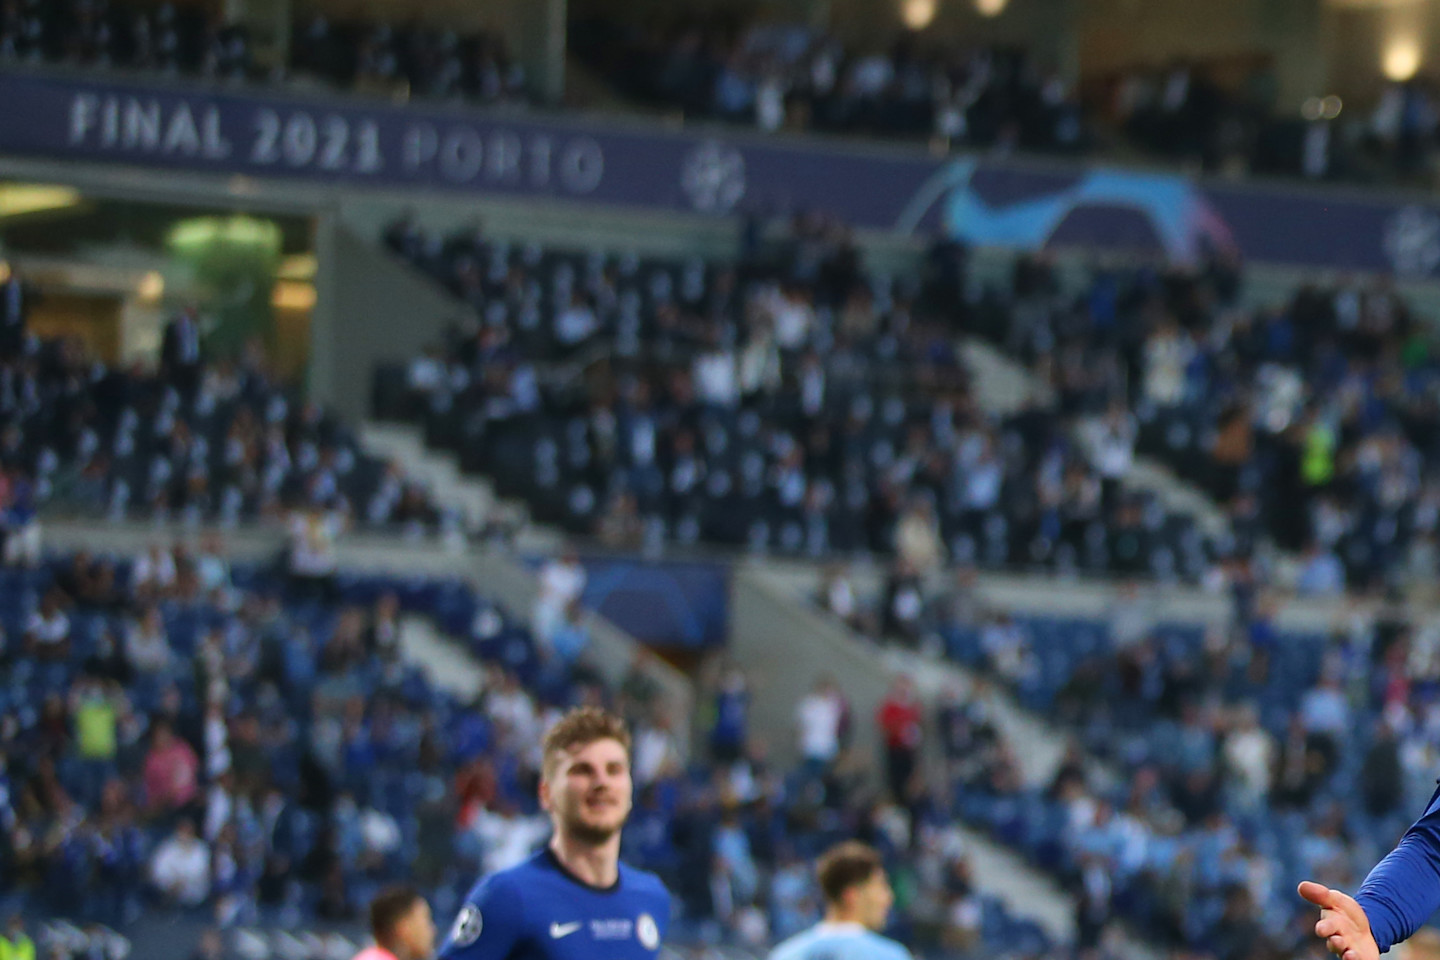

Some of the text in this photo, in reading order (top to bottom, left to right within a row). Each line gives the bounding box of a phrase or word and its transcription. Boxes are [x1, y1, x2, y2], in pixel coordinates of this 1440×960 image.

[68, 93, 604, 194] FINAL 2021 PORTO
